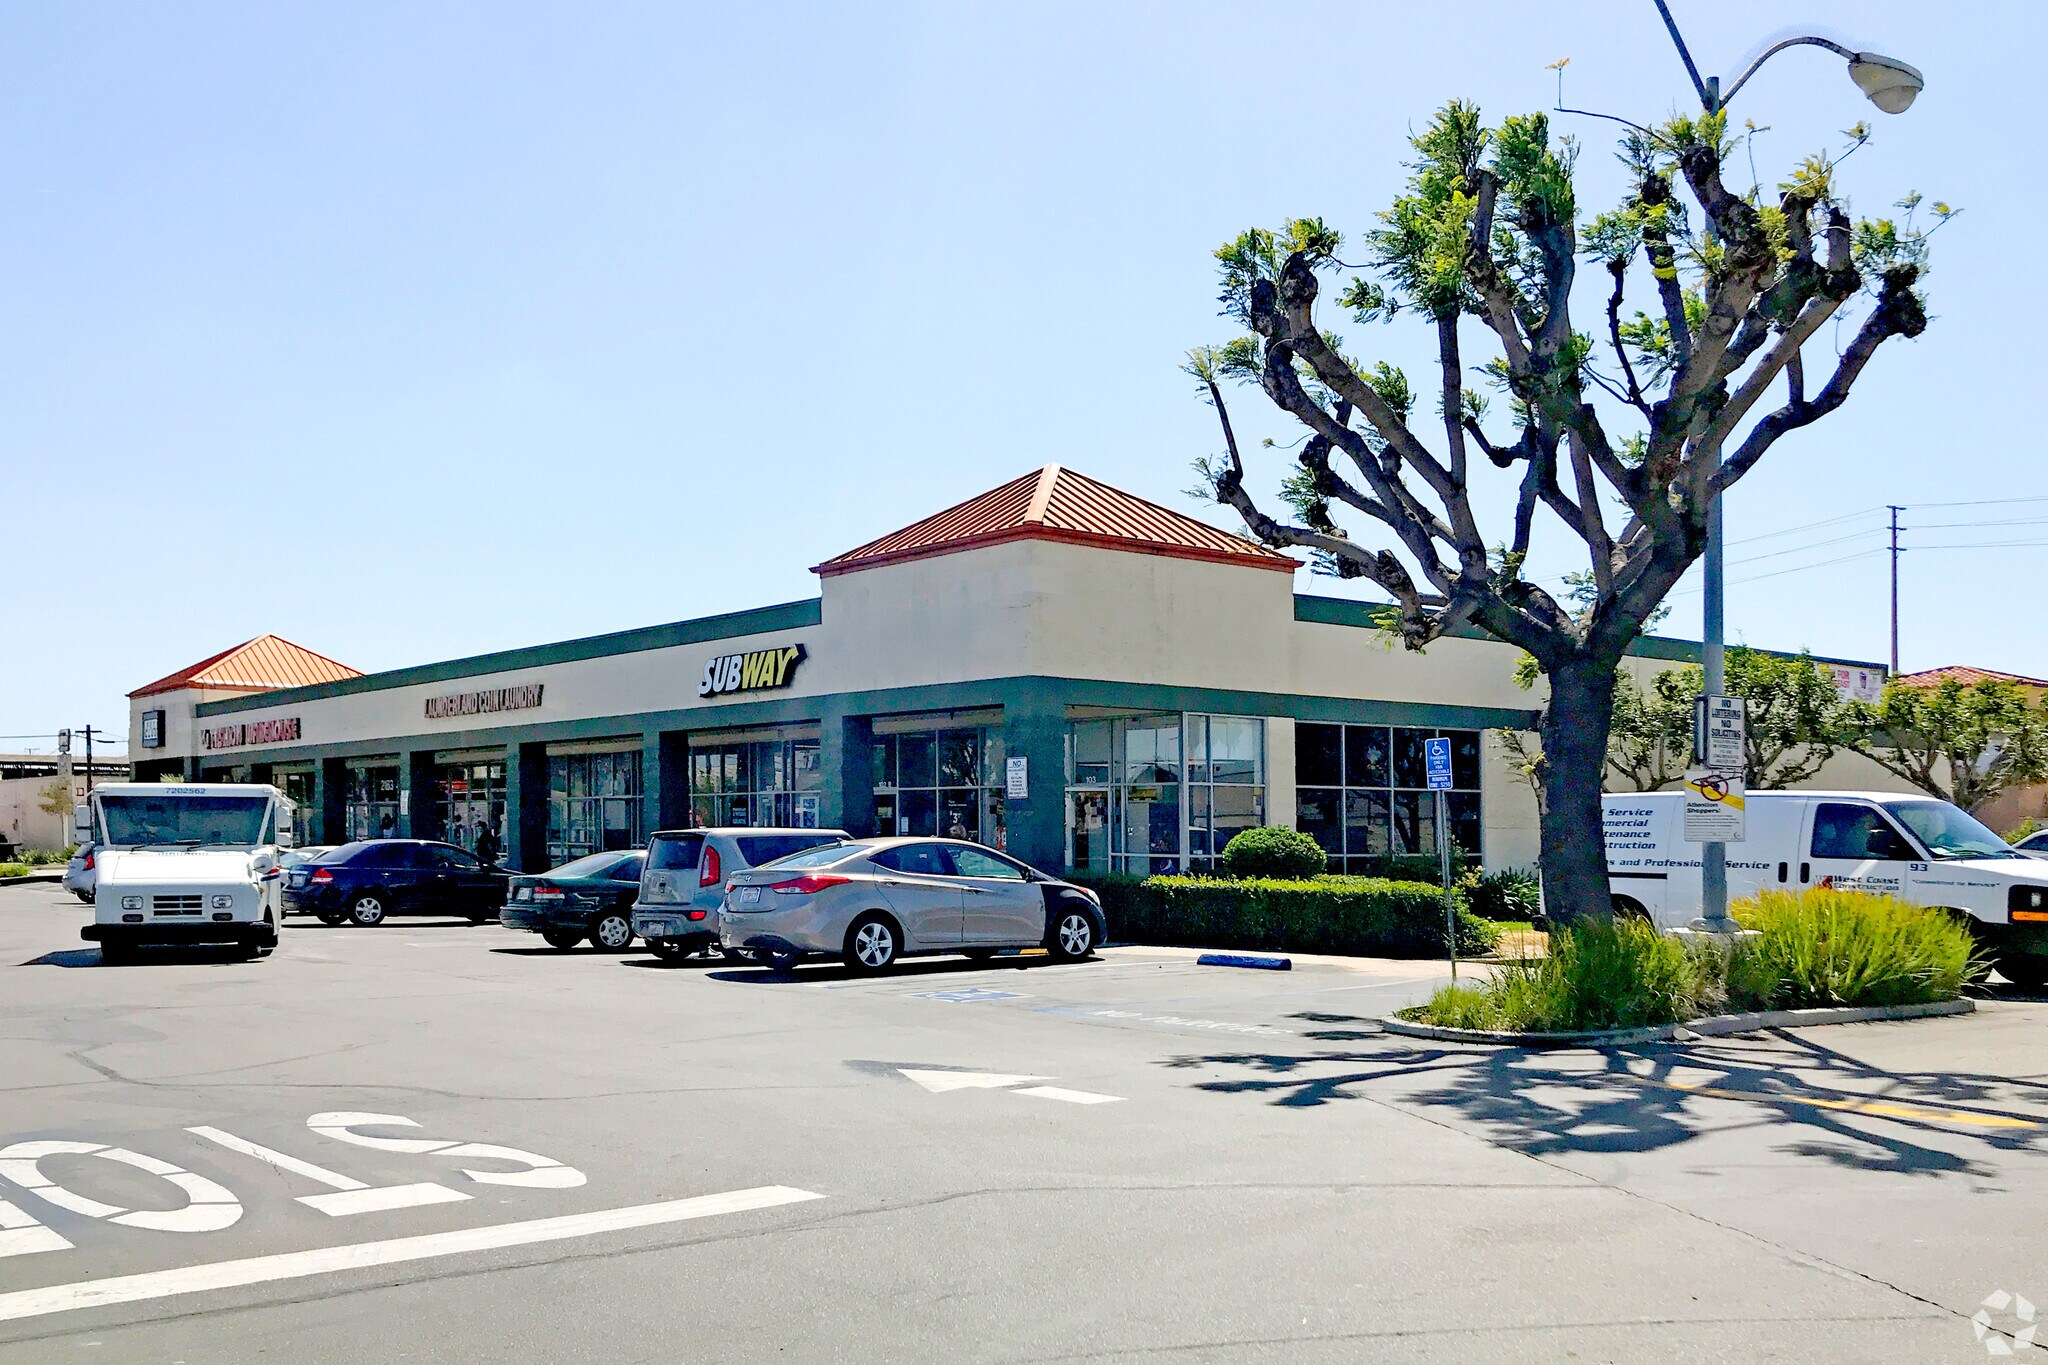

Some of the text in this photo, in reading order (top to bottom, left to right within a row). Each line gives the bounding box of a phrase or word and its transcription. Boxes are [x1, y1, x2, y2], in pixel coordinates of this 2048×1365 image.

[697, 646, 802, 695] SUBWAY
[424, 684, 543, 718] LAUNDERLAND COIN LAUNDRY
[1721, 699, 1732, 708] NO
[1711, 708, 1741, 719] LOITERING
[1721, 720, 1732, 728] NO
[1711, 728, 1741, 739] SOLICITING
[1012, 760, 1021, 768] NO
[1607, 808, 1653, 816] Service
[1619, 858, 1640, 866] and
[1725, 860, 1770, 870] Service
[1909, 863, 1929, 872] 93
[1835, 875, 1900, 885] West Coast
